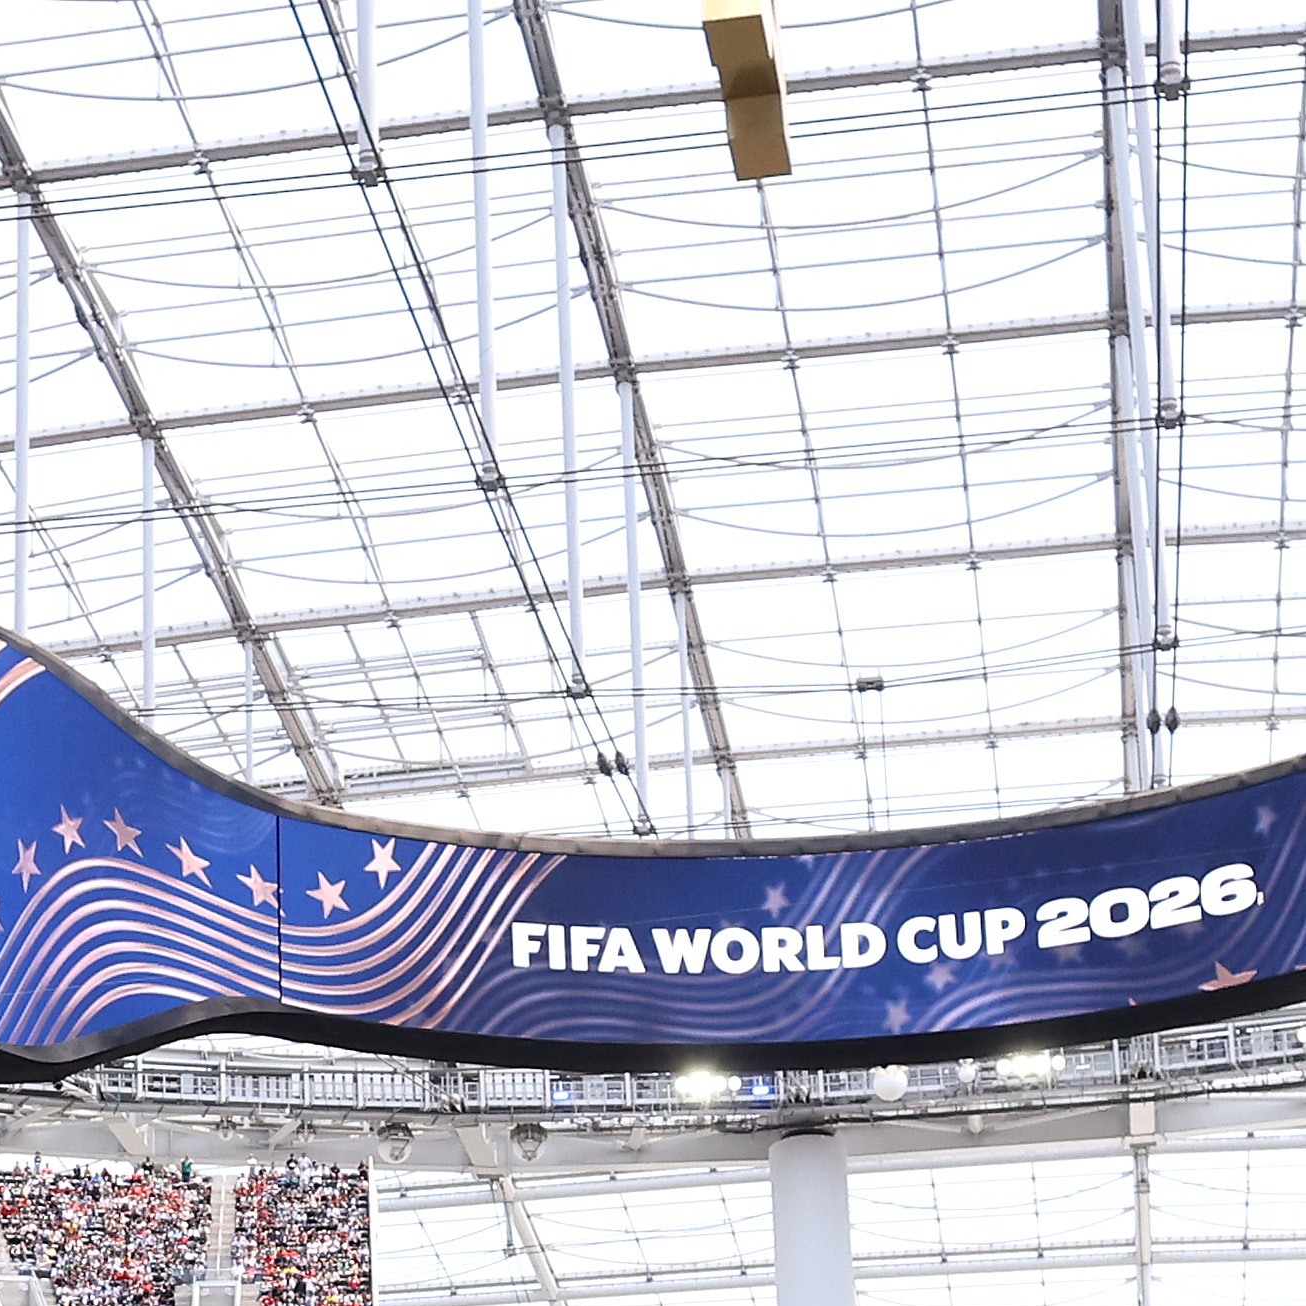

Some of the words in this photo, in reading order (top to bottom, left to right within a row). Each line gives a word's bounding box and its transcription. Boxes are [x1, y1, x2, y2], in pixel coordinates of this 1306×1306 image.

[511, 920, 646, 974] FIFA
[654, 918, 887, 975] WORLD
[897, 907, 1026, 964] CUP
[1035, 861, 1264, 950] 2026
